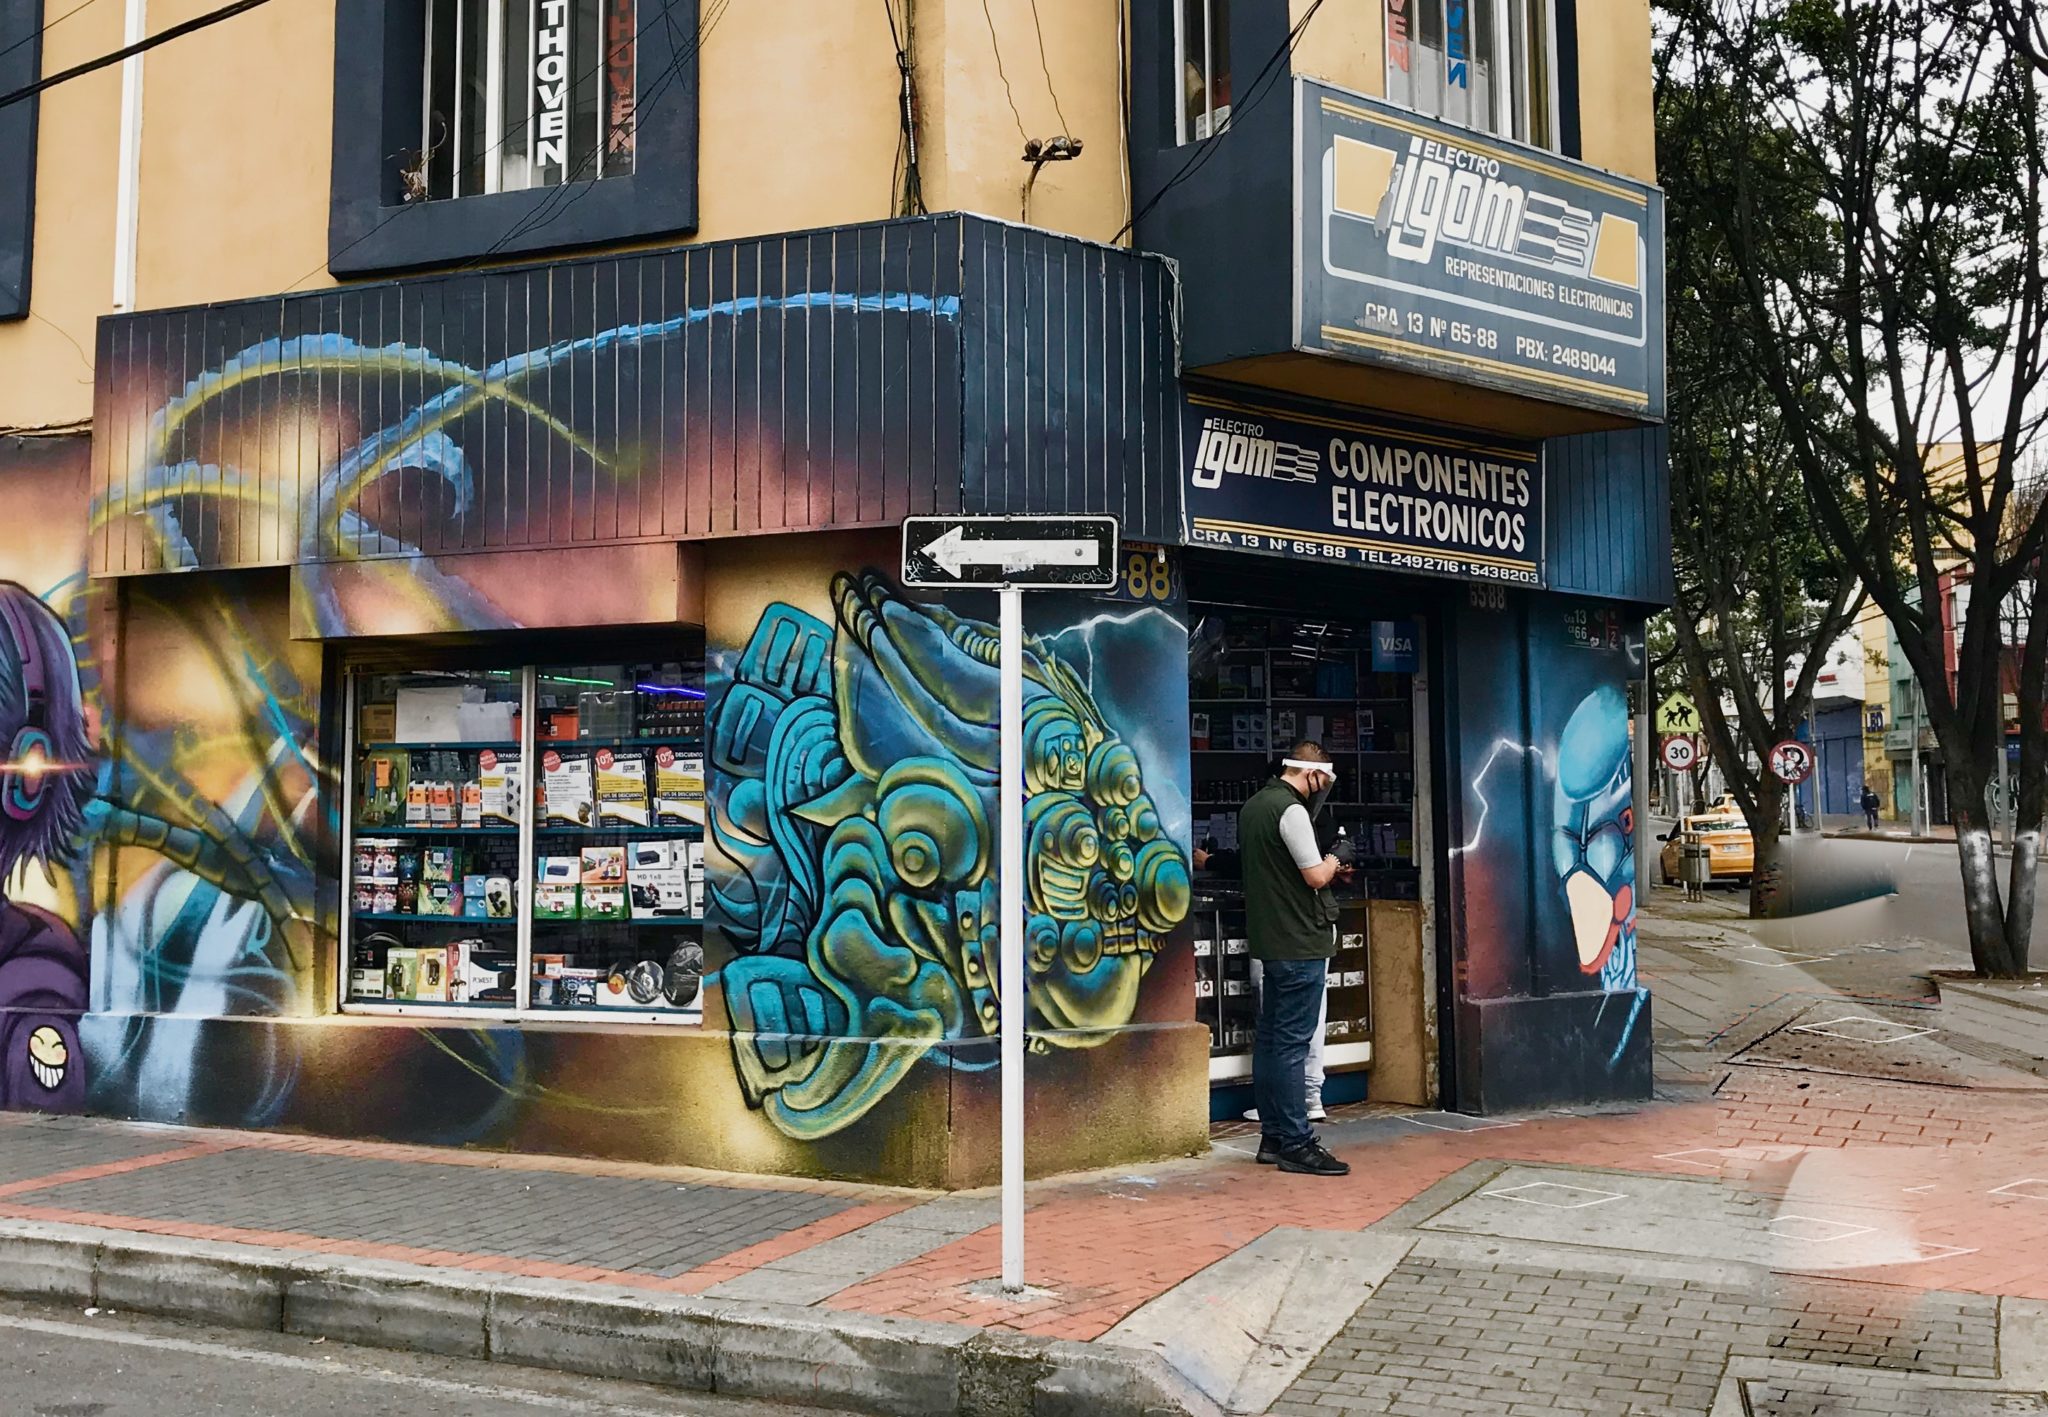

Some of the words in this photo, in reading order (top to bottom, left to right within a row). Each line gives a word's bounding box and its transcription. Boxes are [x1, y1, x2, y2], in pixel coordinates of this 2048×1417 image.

[1423, 140, 1501, 179] ELECTRO
[1445, 256, 1555, 300] REPRESENTACIONES
[1406, 311, 1424, 334] 13
[1552, 344, 1617, 377] 2489044
[1212, 417, 1264, 437] ELECTRO
[1329, 437, 1530, 508] COMPONENTES
[1331, 487, 1526, 553] ELECTRONICOS
[1192, 528, 1232, 545] CRA
[1240, 533, 1260, 548] 13
[1470, 562, 1539, 584] 5438203
[1574, 608, 1587, 625] 13
[1574, 626, 1588, 640] 66
[1379, 636, 1413, 652] VISA
[595, 752, 615, 766] 10%
[655, 750, 675, 764] 10%
[1670, 746, 1689, 760] 30
